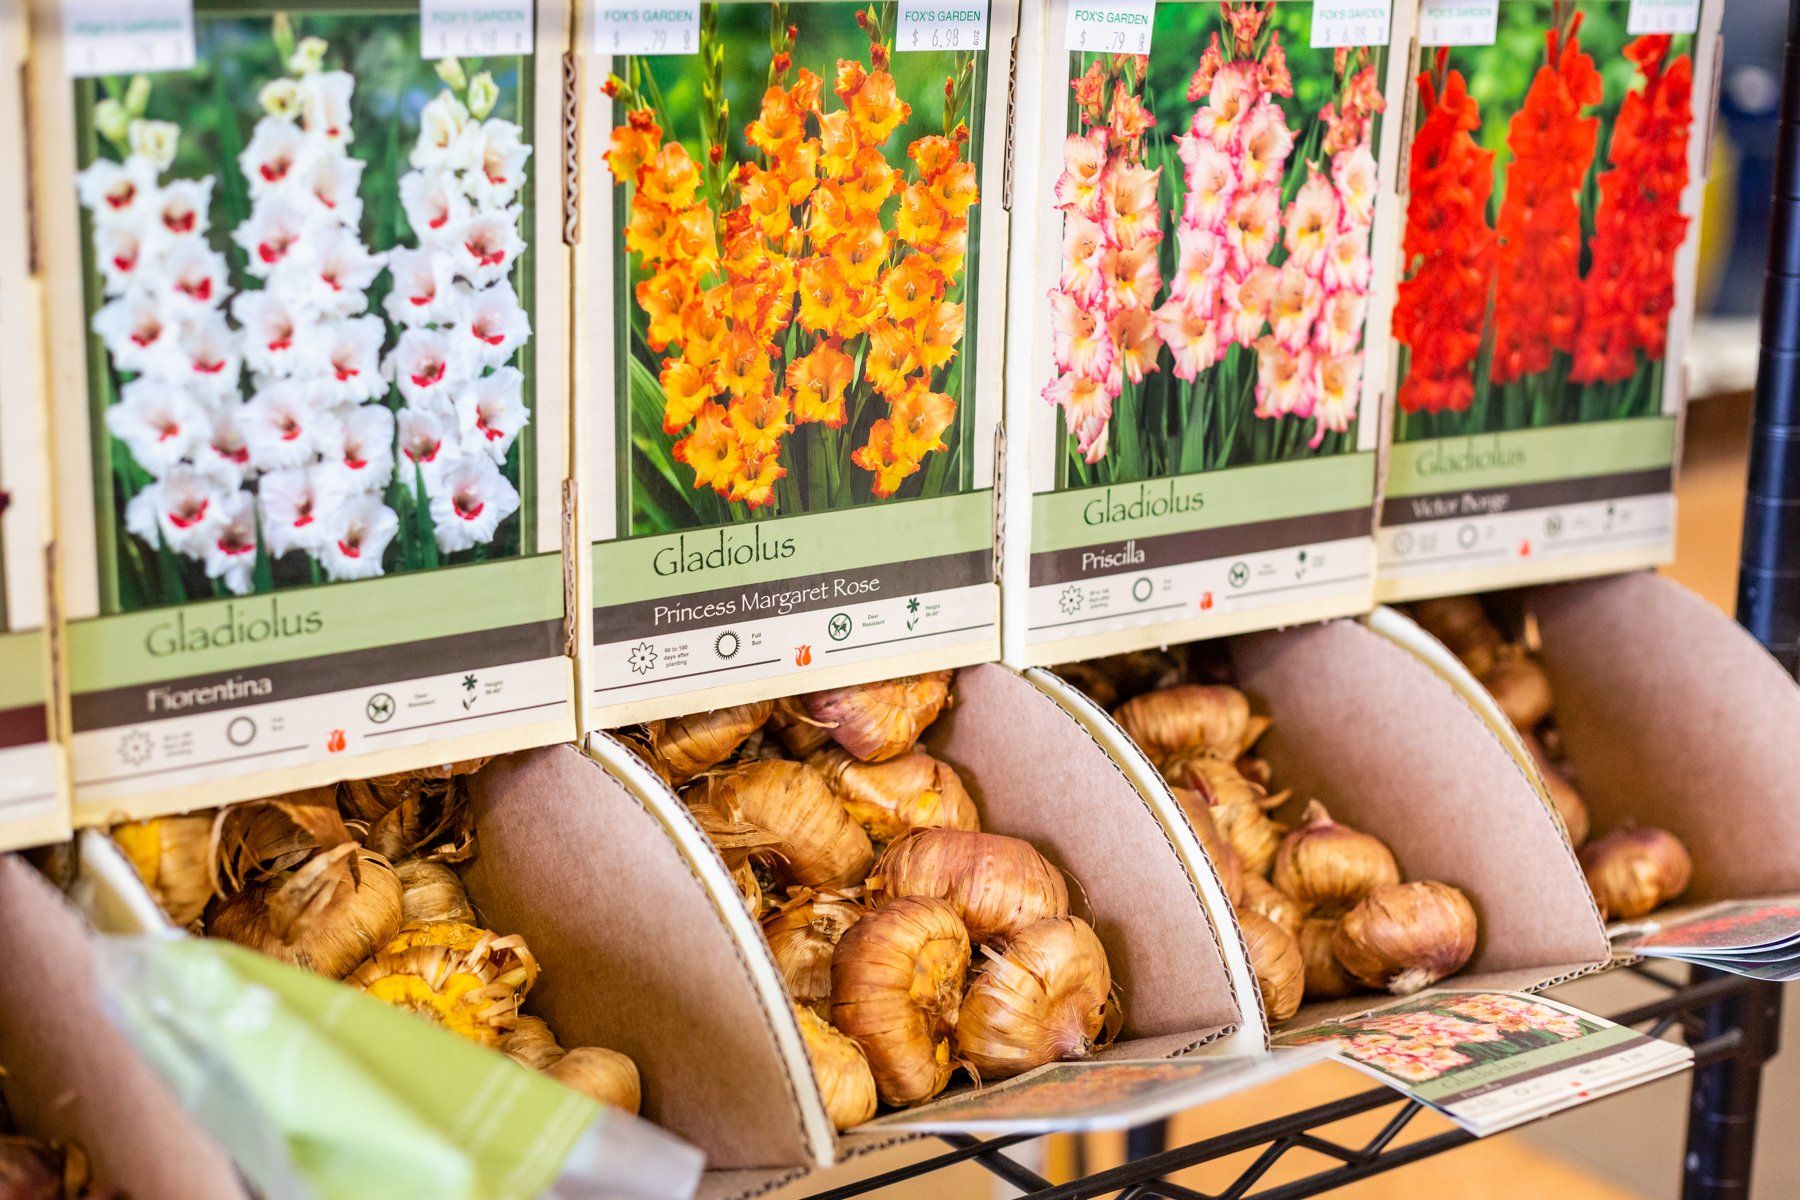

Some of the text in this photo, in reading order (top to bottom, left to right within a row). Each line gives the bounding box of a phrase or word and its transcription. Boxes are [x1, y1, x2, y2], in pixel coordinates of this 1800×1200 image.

[604, 10, 693, 22] FOX'S GARDEN
[905, 10, 981, 22] FOX'S GARDEN
[1075, 10, 1149, 25] FOX'S GARDEN
[912, 27, 960, 48] $ 6.98
[1080, 29, 1126, 50] $ .79
[1414, 434, 1527, 476] Gladiolus
[1083, 480, 1205, 526] Gladiolus
[653, 524, 796, 576] Gladiolus
[1082, 540, 1146, 571] Priscilla
[654, 578, 881, 626] Princess Margaret Rose
[144, 597, 324, 657] Gladiolus
[146, 675, 273, 713] Fiorentina
